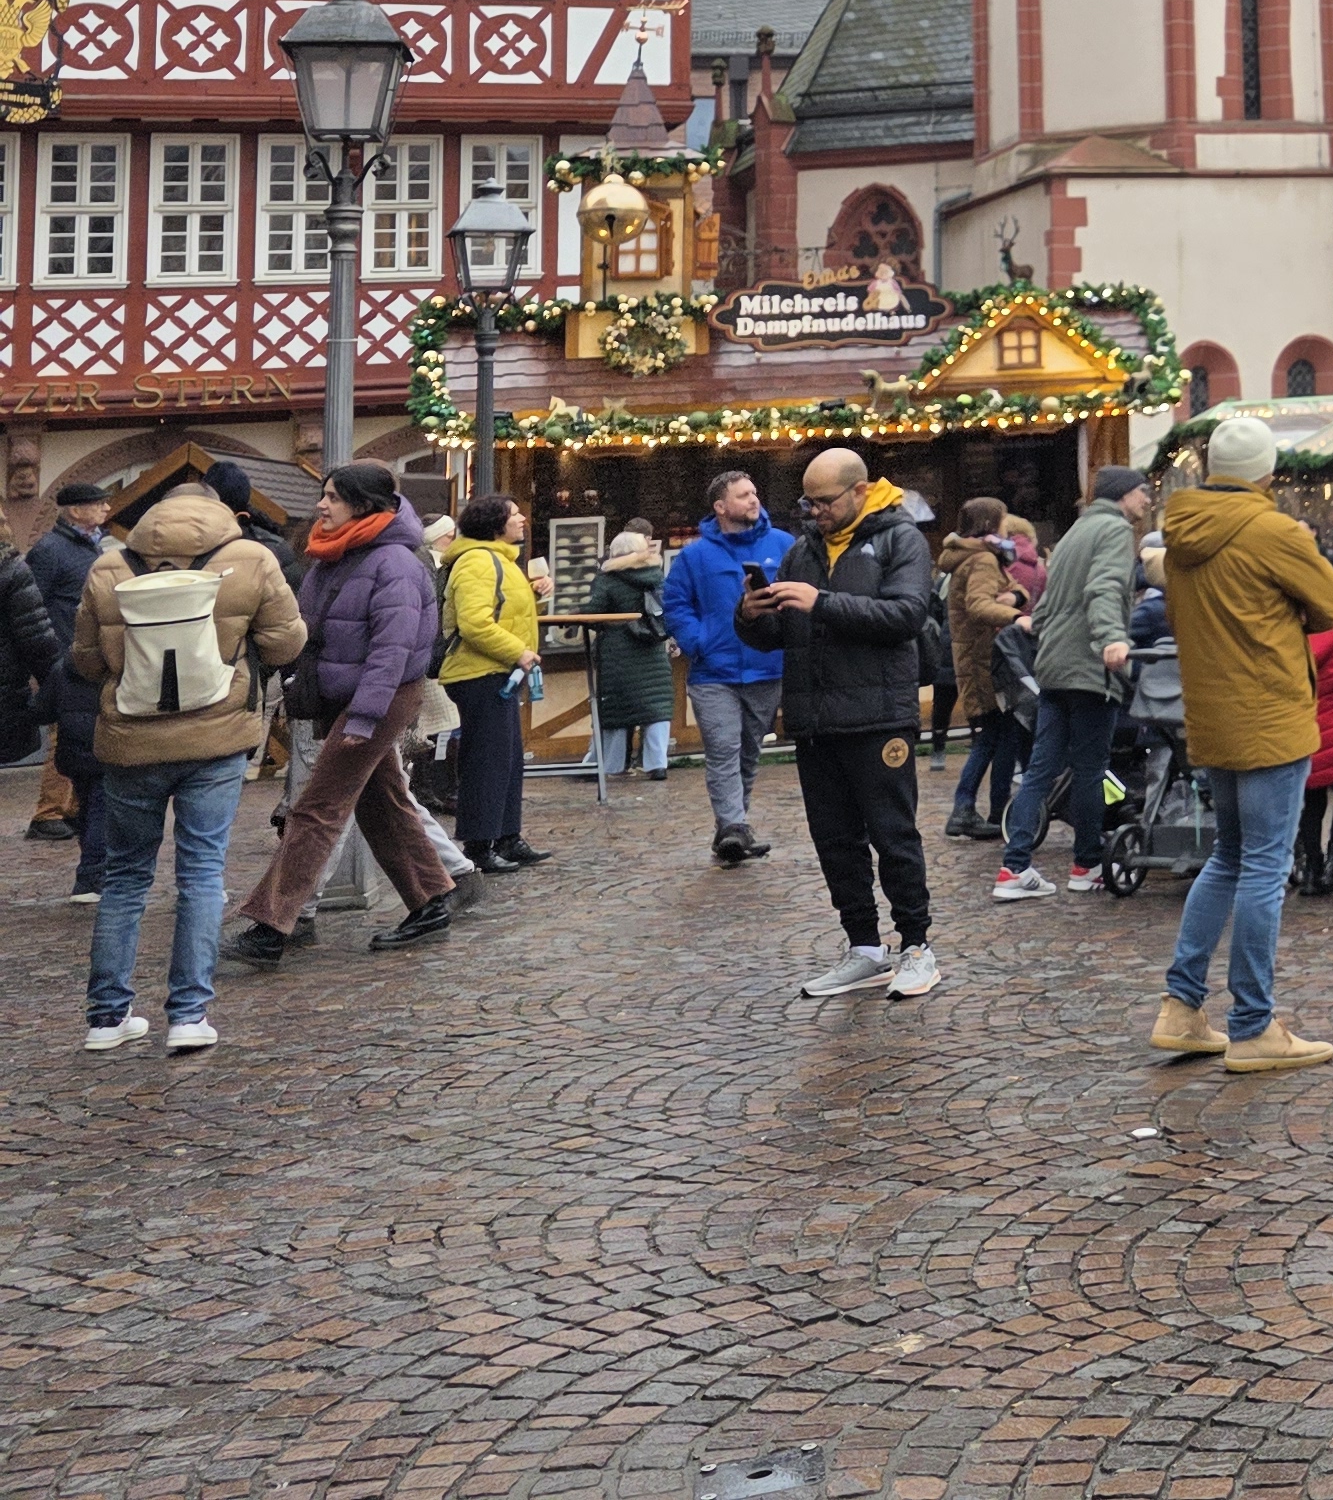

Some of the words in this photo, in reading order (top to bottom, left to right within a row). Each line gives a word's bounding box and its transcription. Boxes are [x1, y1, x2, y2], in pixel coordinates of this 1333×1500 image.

[739, 292, 859, 316] Milchreis
[736, 313, 927, 337] Dampfnudelhaus
[0, 380, 106, 414] ZER
[132, 373, 293, 408] STERN
